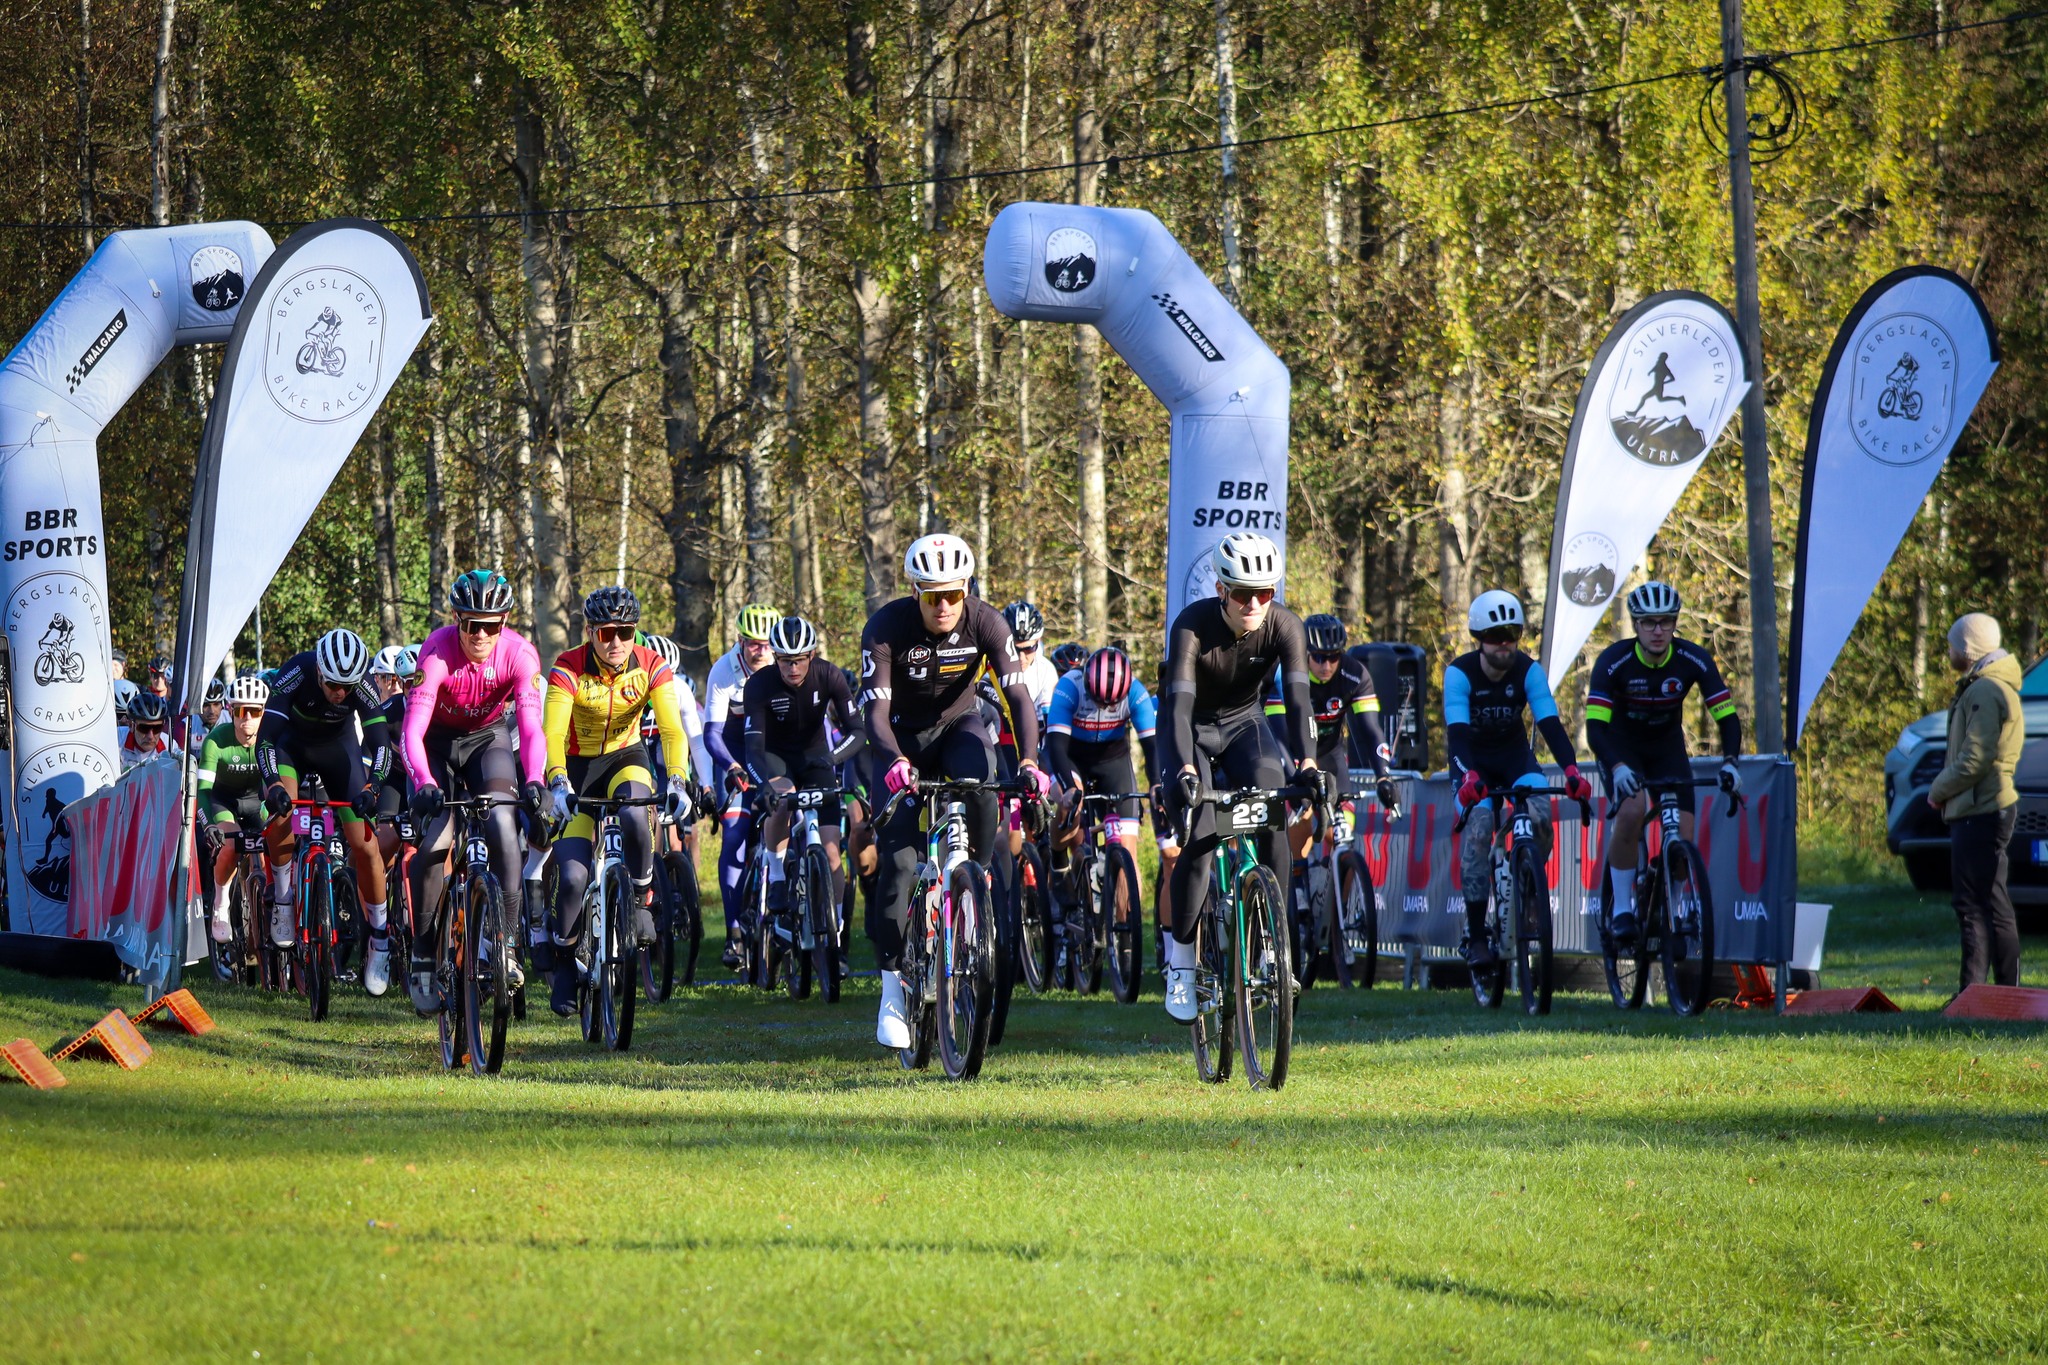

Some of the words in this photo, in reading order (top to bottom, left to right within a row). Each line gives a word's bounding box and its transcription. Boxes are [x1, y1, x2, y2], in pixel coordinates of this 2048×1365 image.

[207, 249, 238, 265] SPORTS
[277, 278, 377, 326] BERGSLAGEN
[1633, 323, 1725, 384] SILVERLEDEN
[1860, 324, 1951, 370] BERGSLAGEN
[274, 375, 309, 409] BIKE
[322, 382, 366, 412] RACE
[1626, 434, 1680, 462] ULTRA
[1858, 419, 1889, 452] BIKE
[1902, 425, 1941, 454] RACE
[1217, 480, 1269, 501] BBR
[25, 508, 78, 532] BBR
[1192, 508, 1282, 530] SPORTS
[4, 536, 97, 562] SPORTS
[9, 584, 101, 632] BERGSLAGEN
[33, 703, 94, 723] GRAVEL
[21, 751, 110, 804] SILVERLEDE
[797, 791, 824, 806] 32
[1232, 802, 1268, 824] 23
[245, 837, 264, 849] 54
[311, 825, 323, 840] 6
[604, 834, 622, 852] 10
[466, 841, 488, 862] 19
